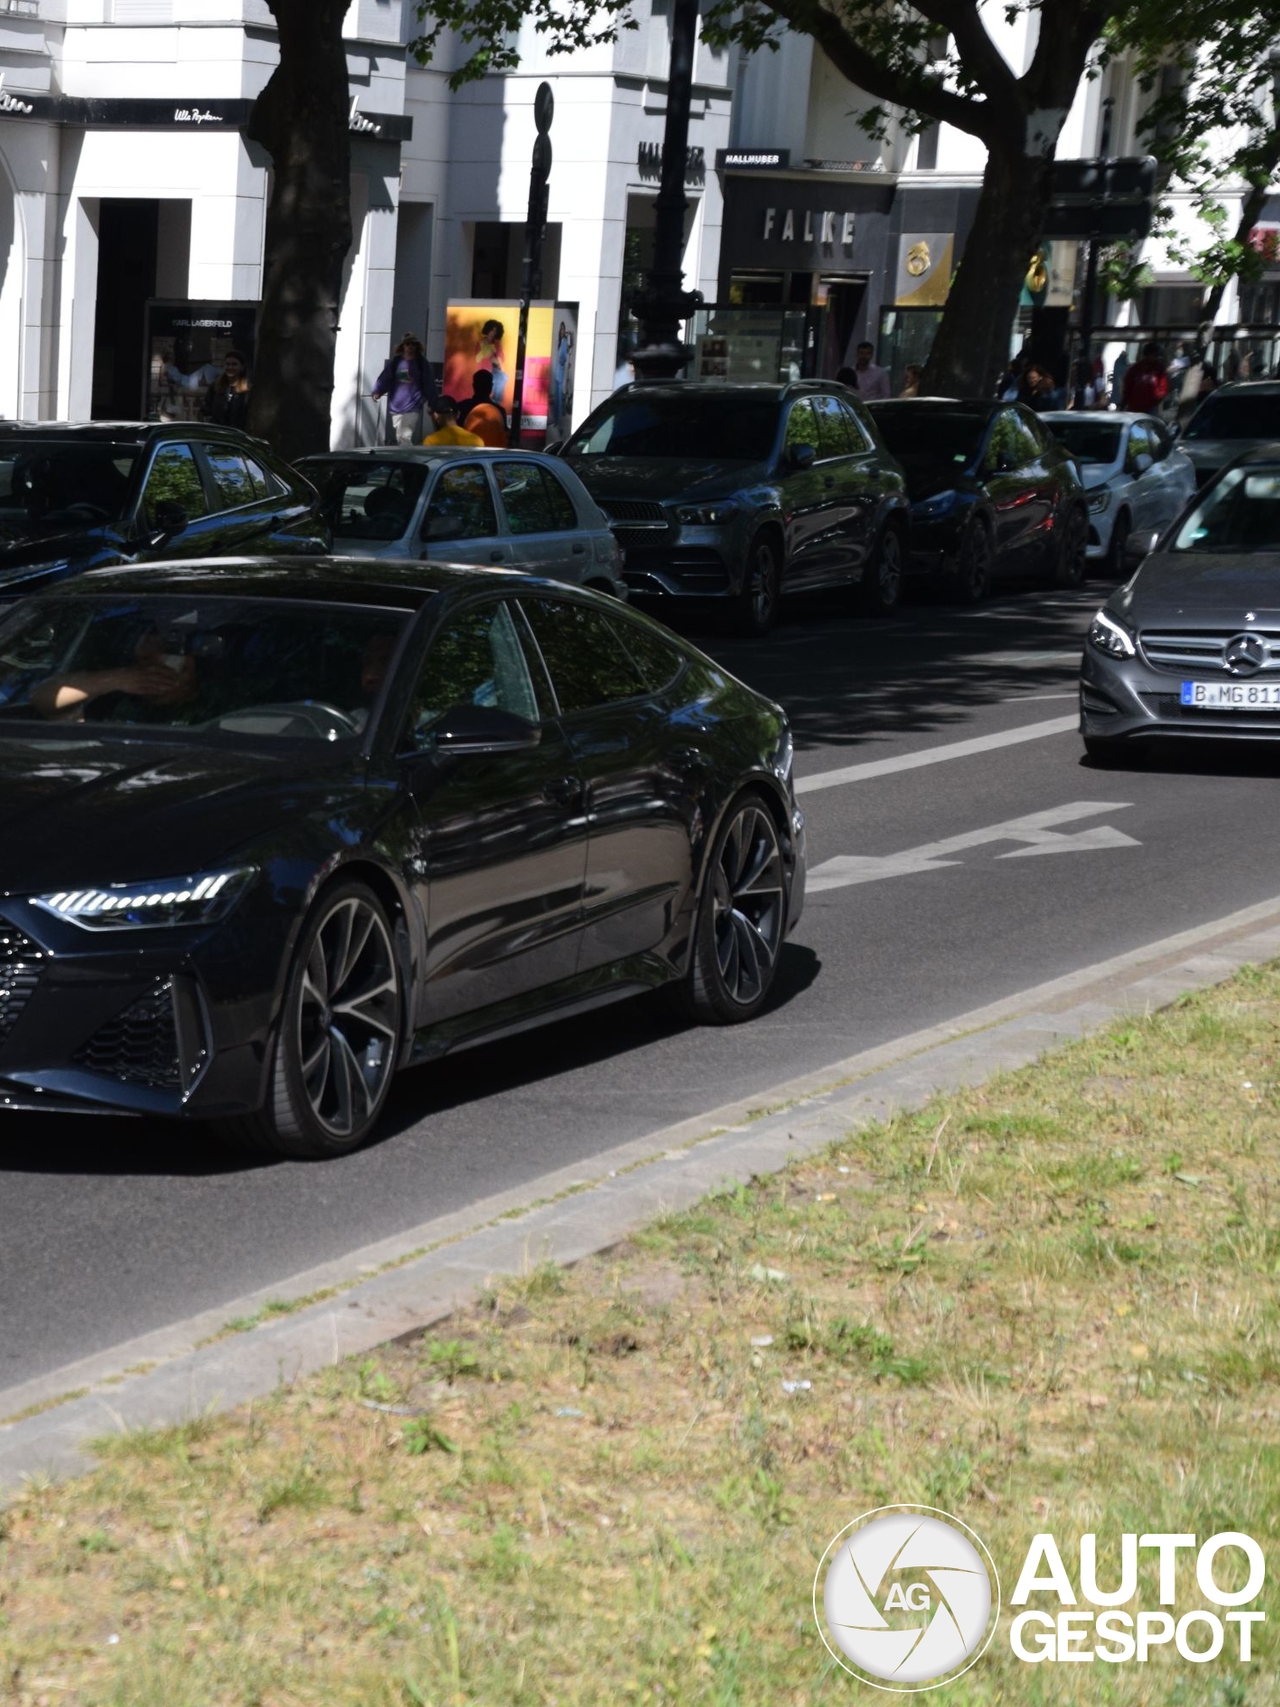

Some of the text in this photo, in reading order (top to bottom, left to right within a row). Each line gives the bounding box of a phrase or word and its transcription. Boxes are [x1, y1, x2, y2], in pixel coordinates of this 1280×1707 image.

[174, 108, 223, 124] Ulla Popken
[725, 154, 780, 165] HALLHUBER
[763, 208, 856, 244] FALKE
[172, 319, 233, 328] KARL LAGERFELD
[1195, 685, 1206, 702] B
[1219, 687, 1243, 703] MG
